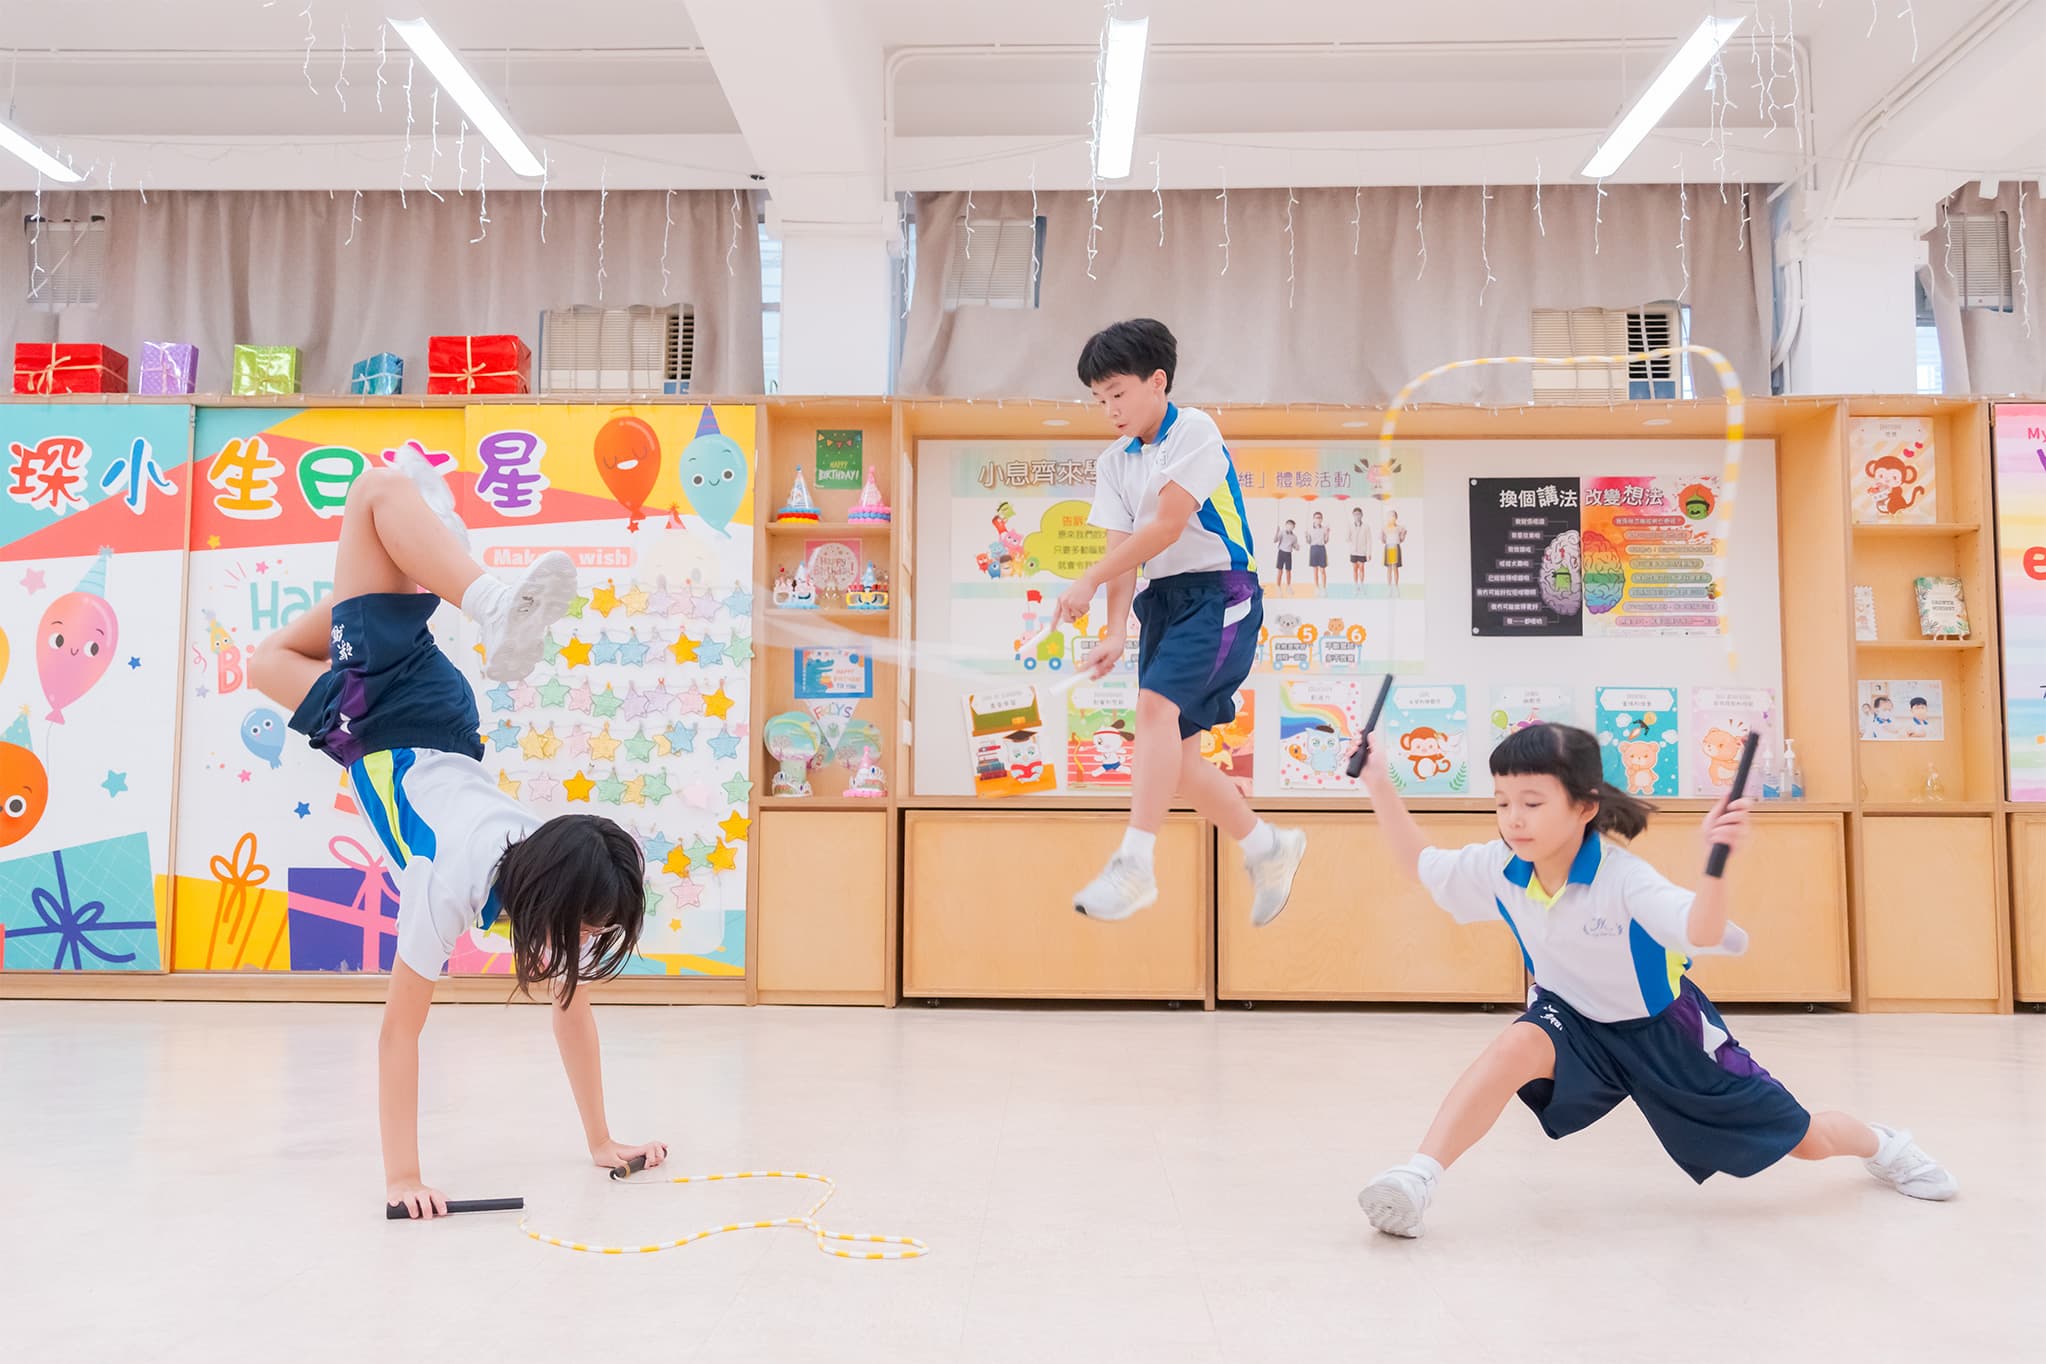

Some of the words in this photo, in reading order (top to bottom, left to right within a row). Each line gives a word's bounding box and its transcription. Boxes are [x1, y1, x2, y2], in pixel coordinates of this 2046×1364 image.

[7, 431, 550, 514] 琛小生日星
[1499, 485, 1578, 508] 換個講法
[1584, 484, 1665, 506] 改變想法
[494, 549, 538, 565] Mak
[578, 549, 628, 566] wish
[1303, 627, 1313, 642] 5
[1351, 629, 1362, 643] 6
